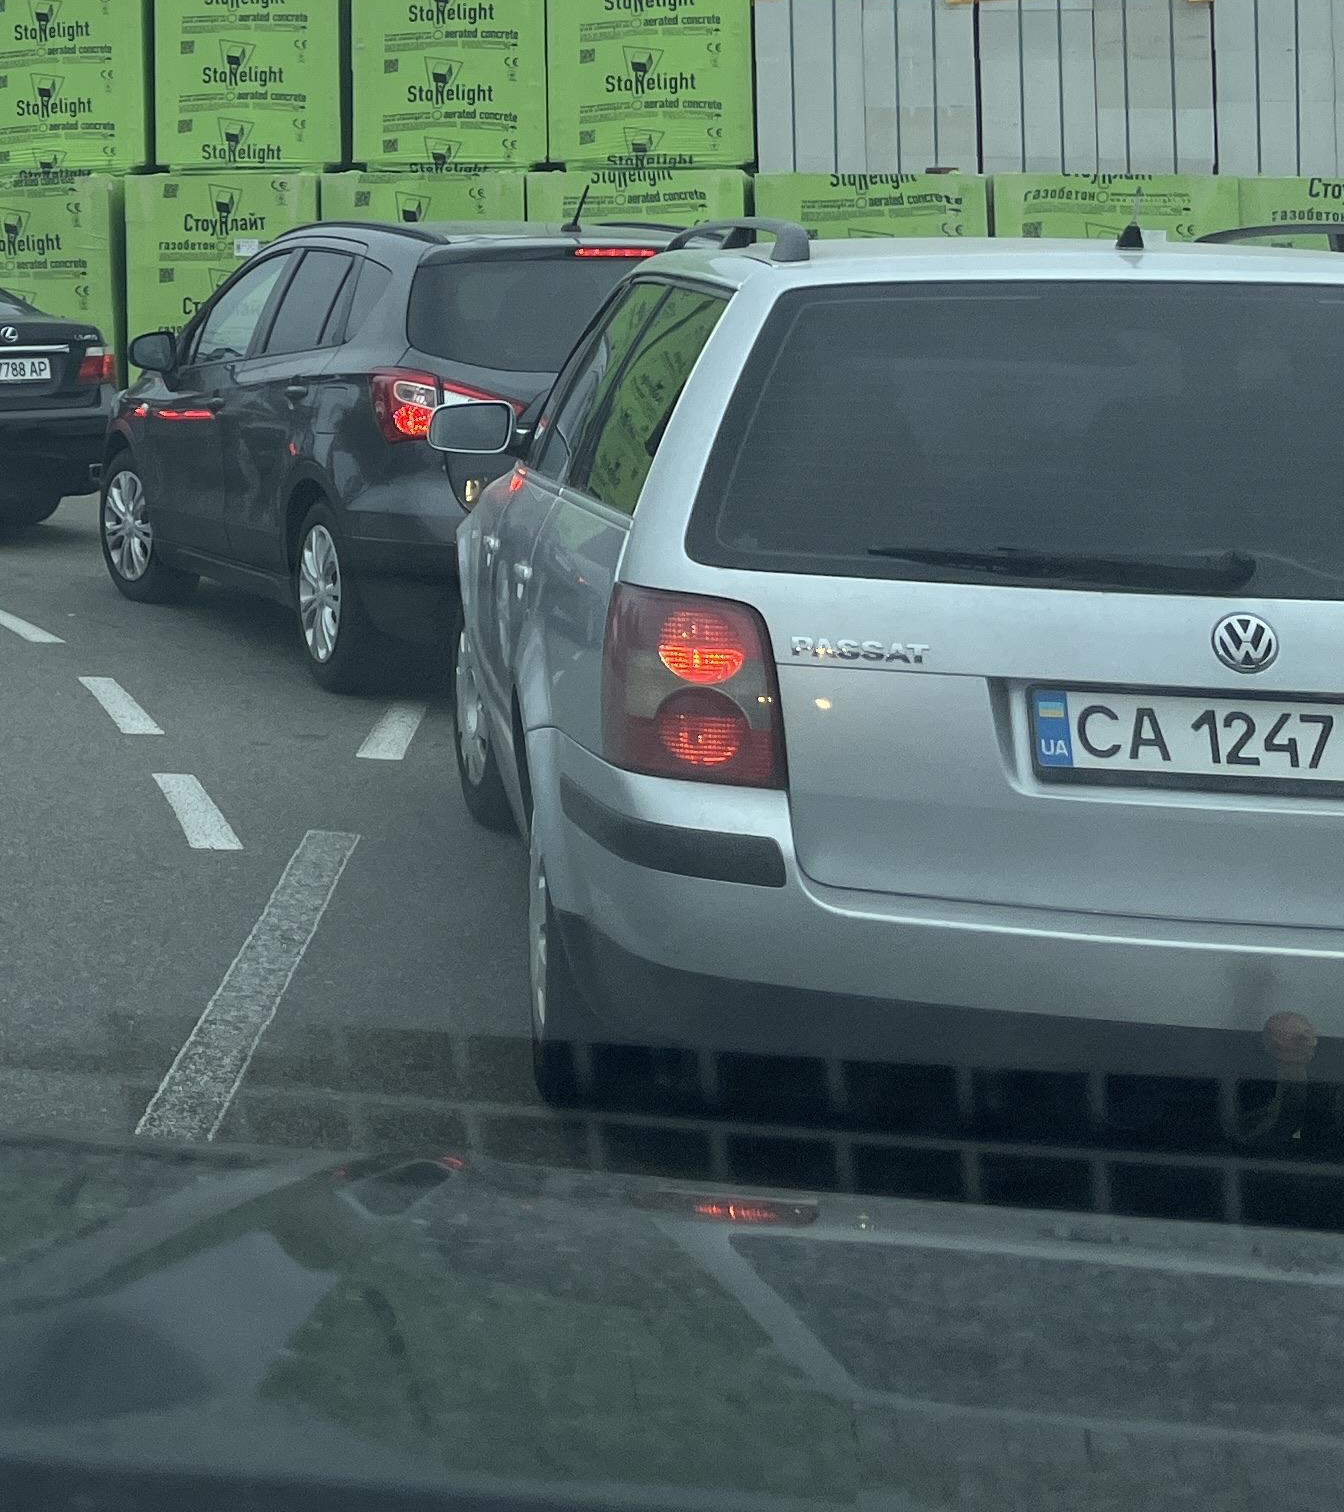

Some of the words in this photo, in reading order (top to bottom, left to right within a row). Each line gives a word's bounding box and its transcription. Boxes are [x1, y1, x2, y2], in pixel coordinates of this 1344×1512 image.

[30, 360, 47, 377] AP
[791, 636, 930, 664] PASSAT
[1041, 738, 1069, 757] UA
[1077, 705, 1171, 762] CA
[1191, 709, 1334, 769] 1247
